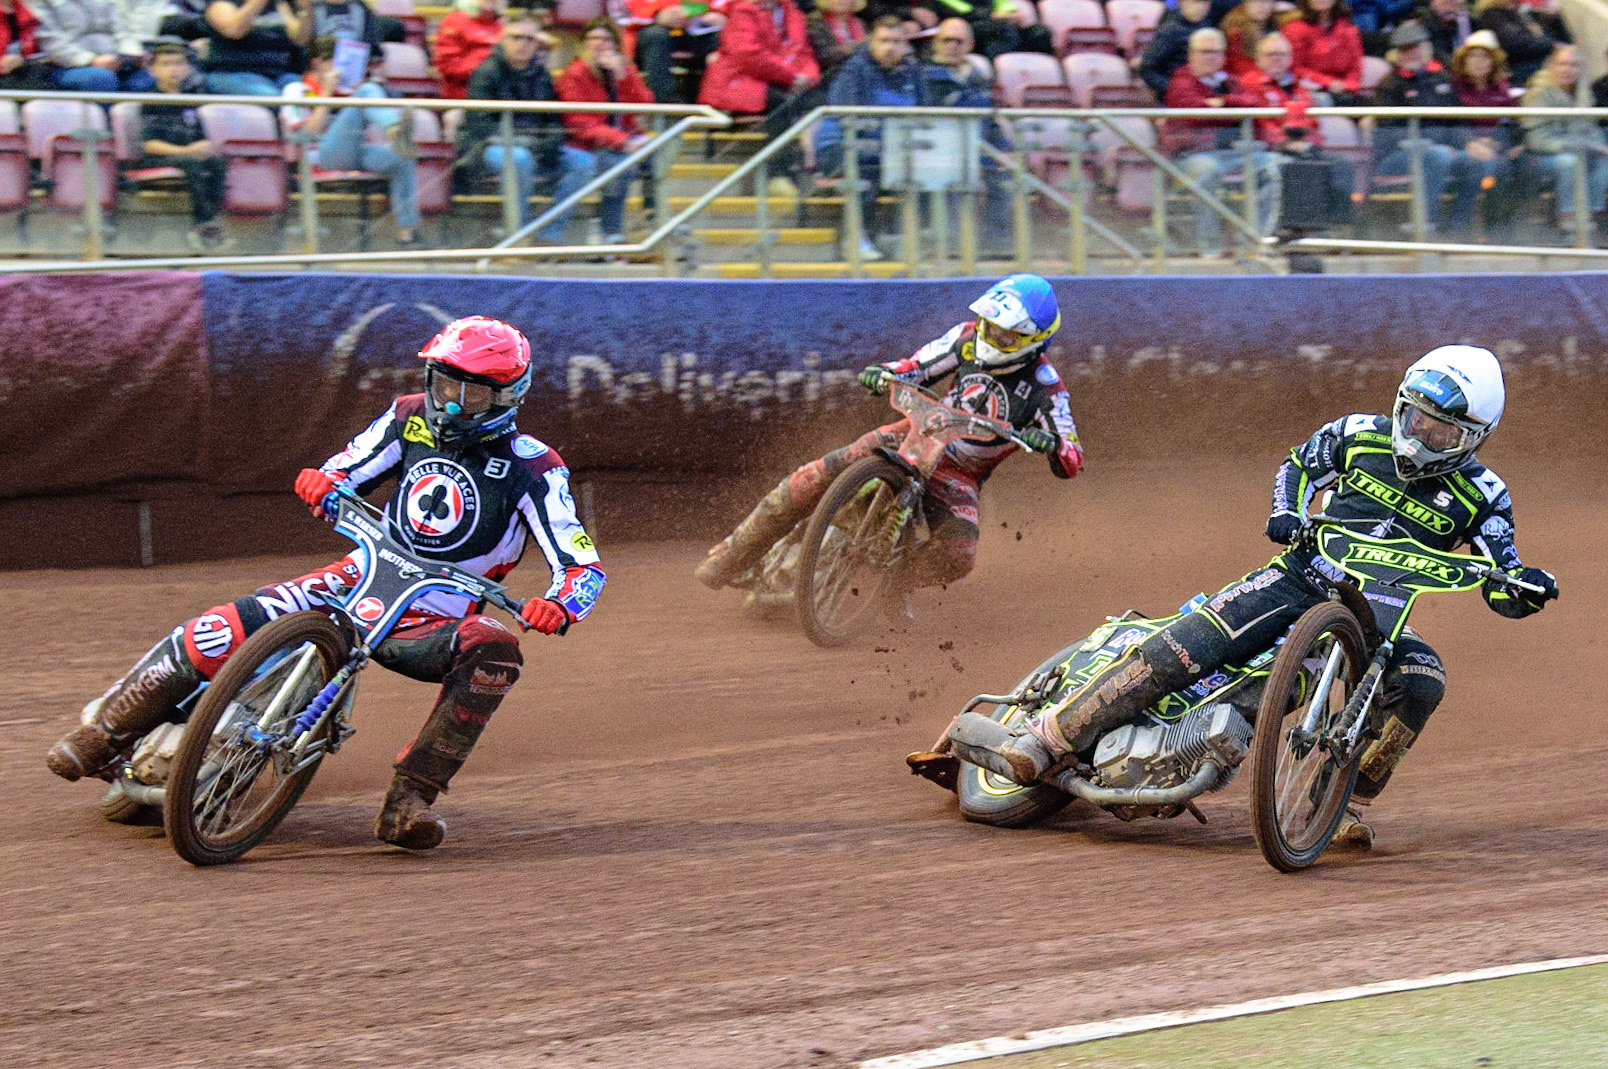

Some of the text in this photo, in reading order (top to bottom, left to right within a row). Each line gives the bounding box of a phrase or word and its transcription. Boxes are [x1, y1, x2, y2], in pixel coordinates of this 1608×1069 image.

[409, 464, 476, 511] BELLE VUE ACES
[1356, 475, 1449, 531] TRU MIX
